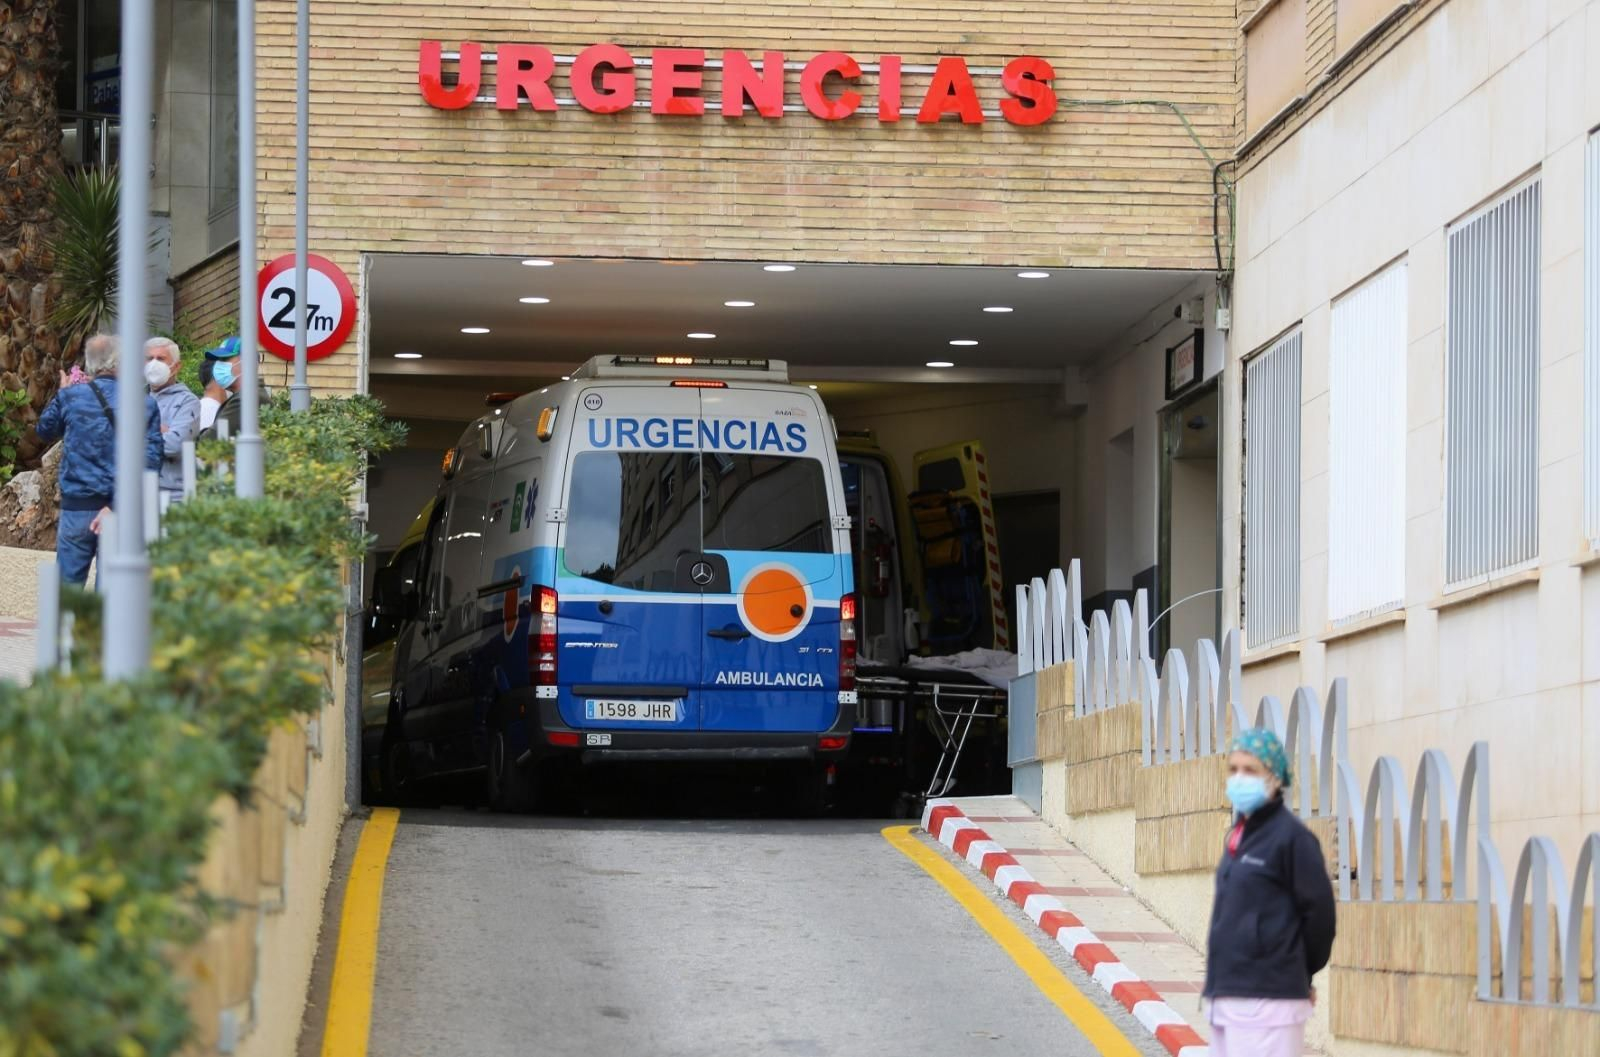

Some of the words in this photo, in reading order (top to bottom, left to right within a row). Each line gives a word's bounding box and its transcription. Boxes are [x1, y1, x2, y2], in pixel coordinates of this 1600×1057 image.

[418, 40, 1058, 127] URGENCIAS
[588, 418, 807, 452] URGENCIAS
[715, 671, 824, 687] AMBULANCIA
[599, 702, 637, 717] 1598
[643, 704, 671, 718] JHR
